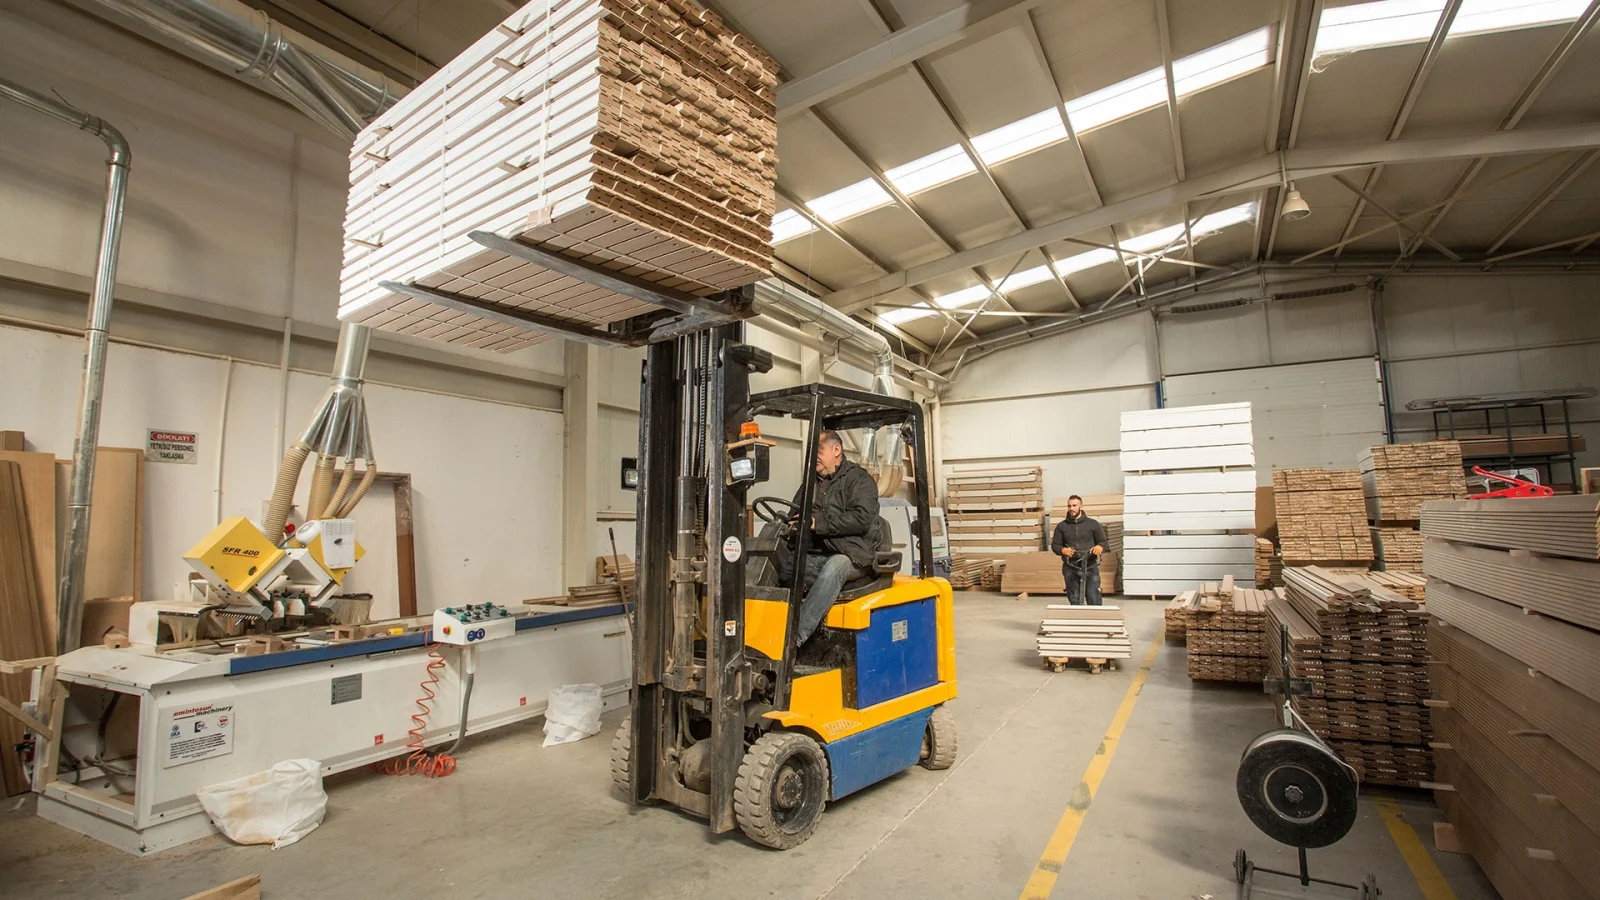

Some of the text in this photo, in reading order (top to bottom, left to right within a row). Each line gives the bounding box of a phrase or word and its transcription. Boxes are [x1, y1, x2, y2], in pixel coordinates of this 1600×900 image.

[172, 444, 194, 452] PERSONEL
[222, 546, 241, 554] SFR
[195, 706, 233, 716] machinery
